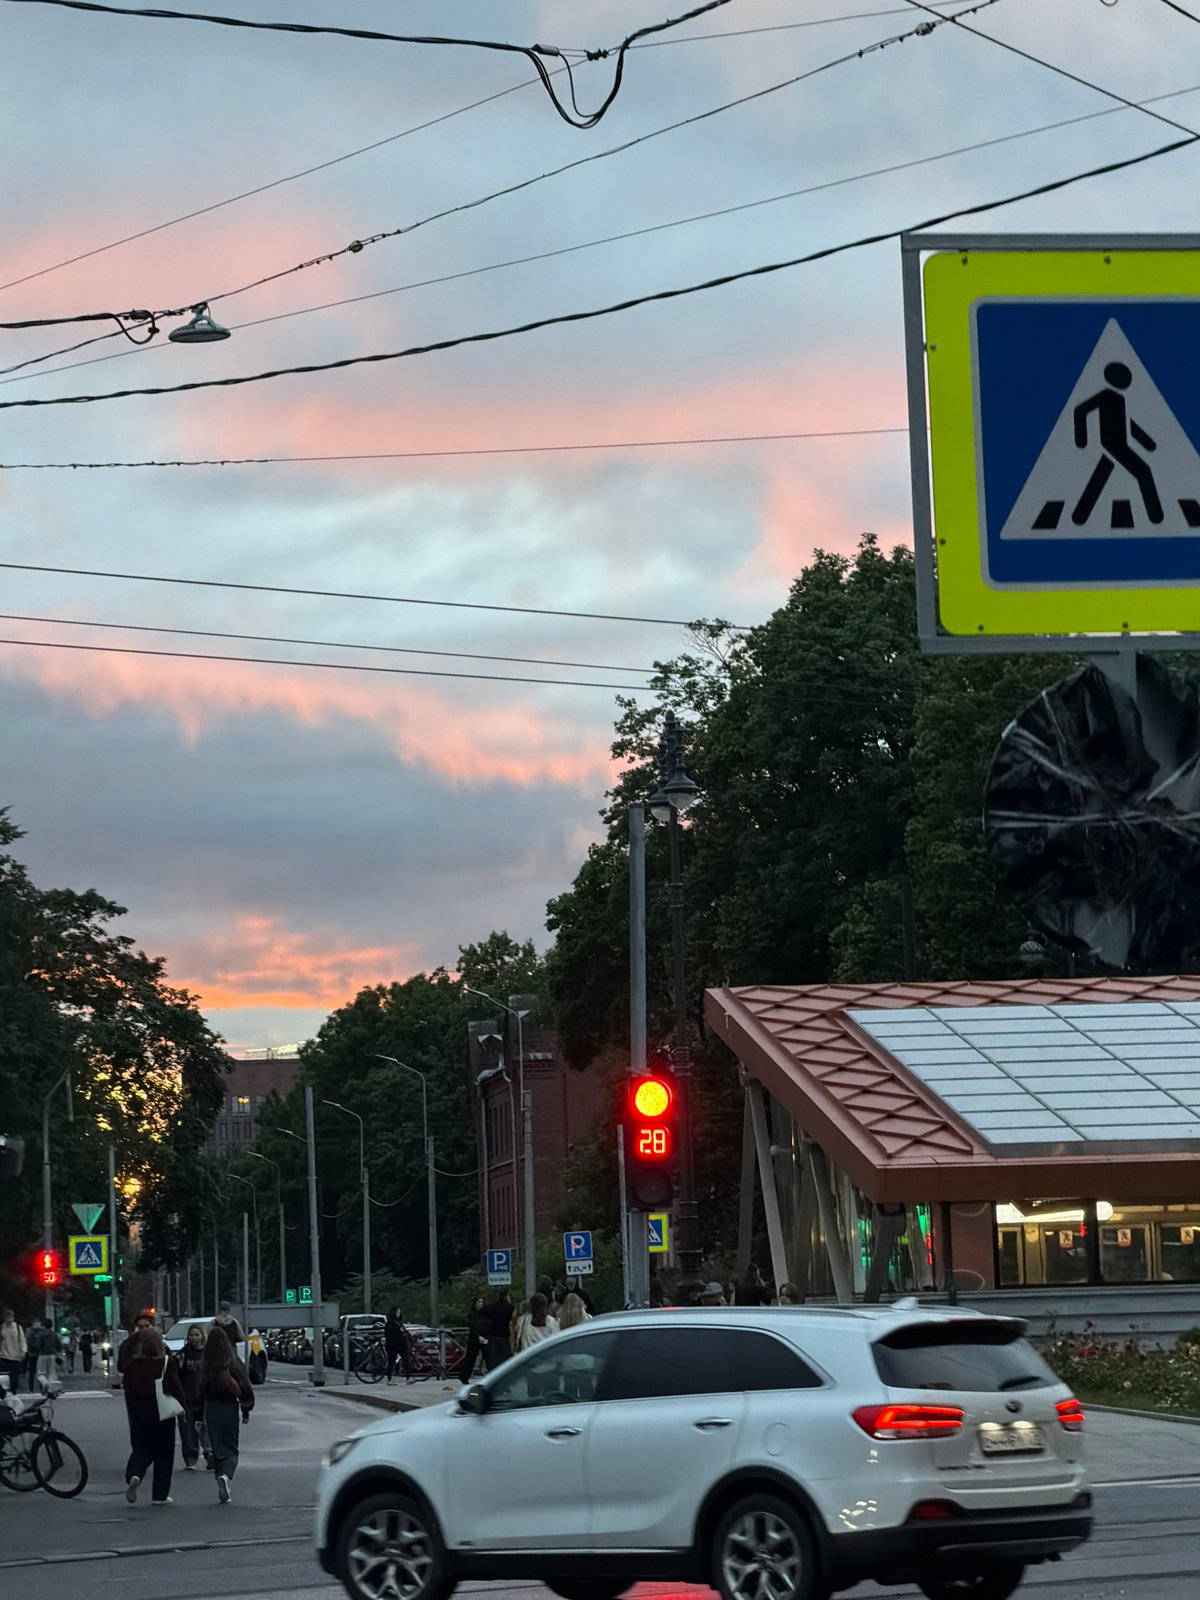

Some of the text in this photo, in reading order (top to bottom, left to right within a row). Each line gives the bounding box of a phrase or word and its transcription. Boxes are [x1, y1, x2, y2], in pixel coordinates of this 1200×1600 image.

[639, 1129, 665, 1154] 28
[570, 1235, 585, 1257] P
[493, 1252, 507, 1271] P
